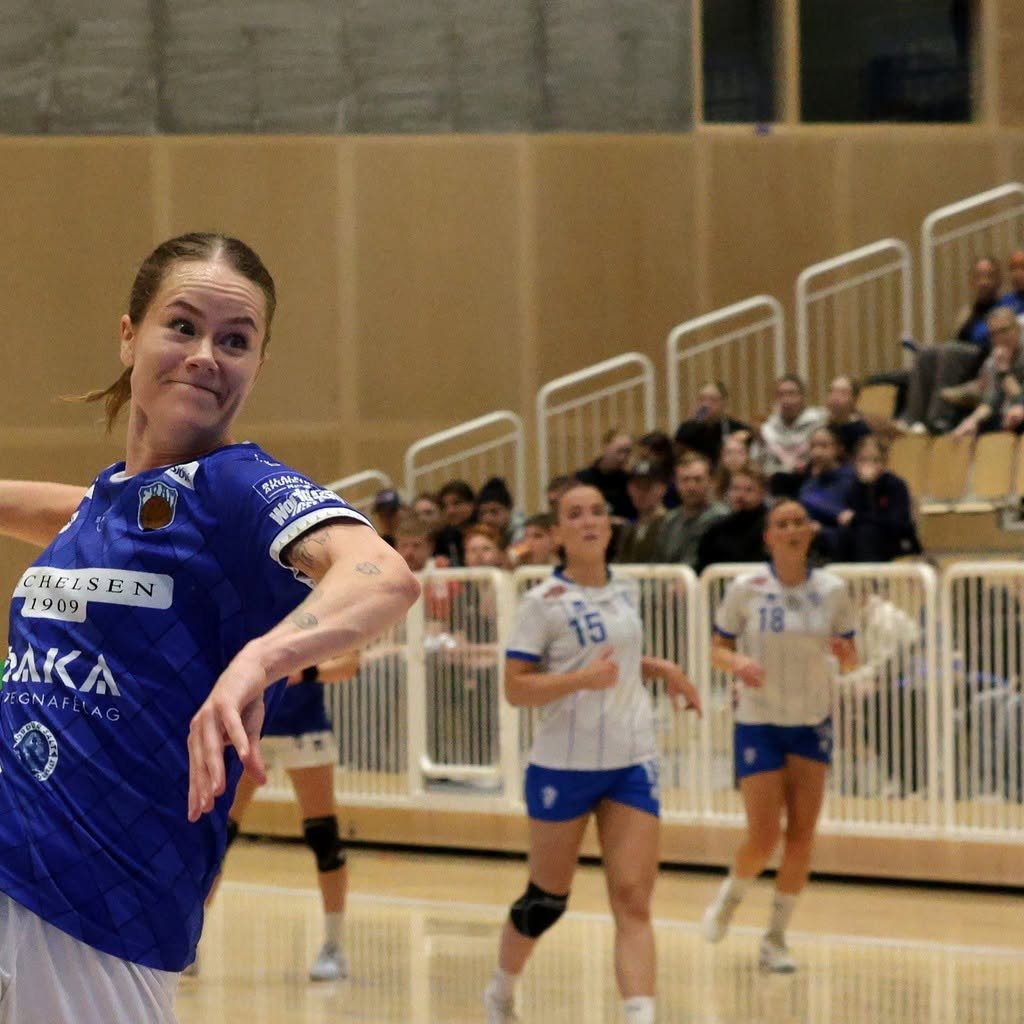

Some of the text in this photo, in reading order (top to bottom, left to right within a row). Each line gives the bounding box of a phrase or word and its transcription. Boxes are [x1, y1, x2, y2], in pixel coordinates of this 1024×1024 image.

[21, 574, 156, 598] CHELSEN
[29, 597, 79, 614] 1909
[569, 612, 607, 648] 15
